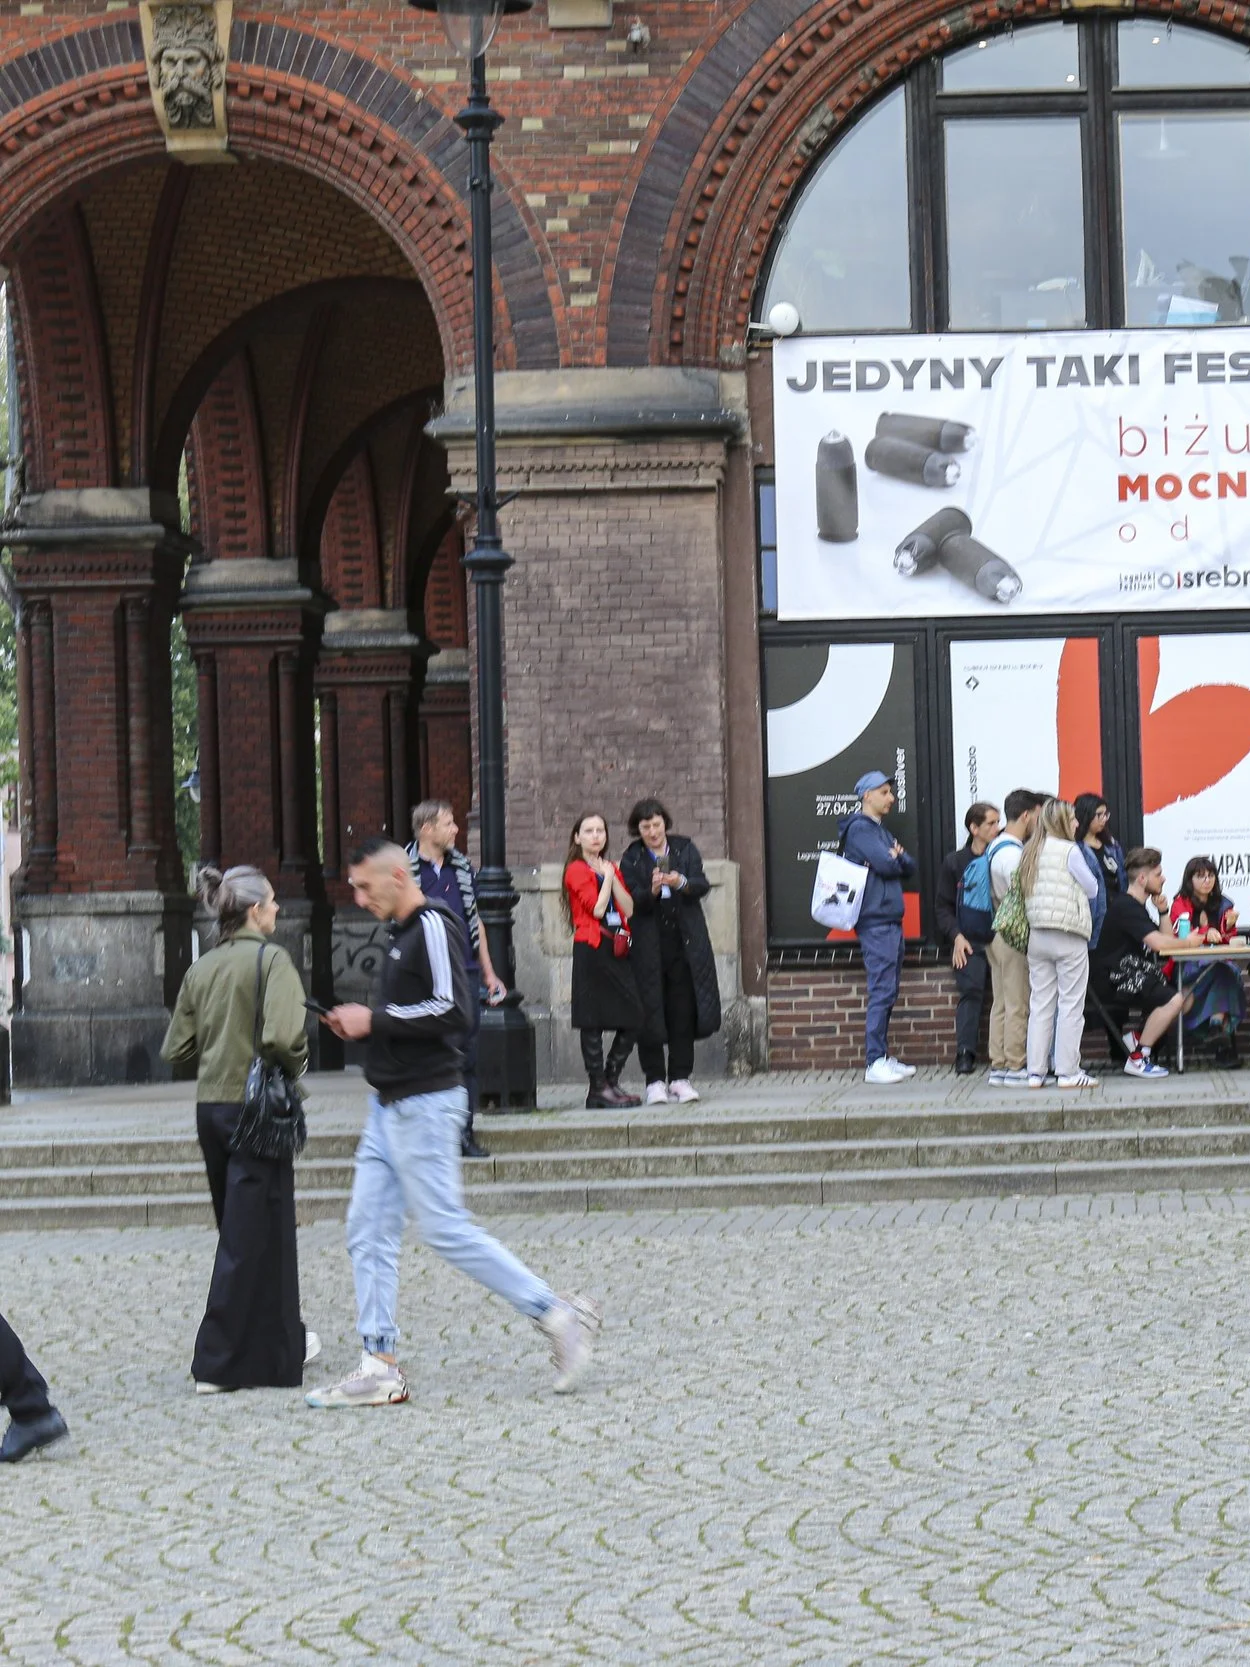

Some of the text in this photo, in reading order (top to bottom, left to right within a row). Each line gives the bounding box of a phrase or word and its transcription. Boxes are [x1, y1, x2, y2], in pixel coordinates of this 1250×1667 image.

[786, 355, 1005, 393] JEDYNY
[1026, 353, 1140, 389] TAKI
[1118, 514, 1189, 543] od
